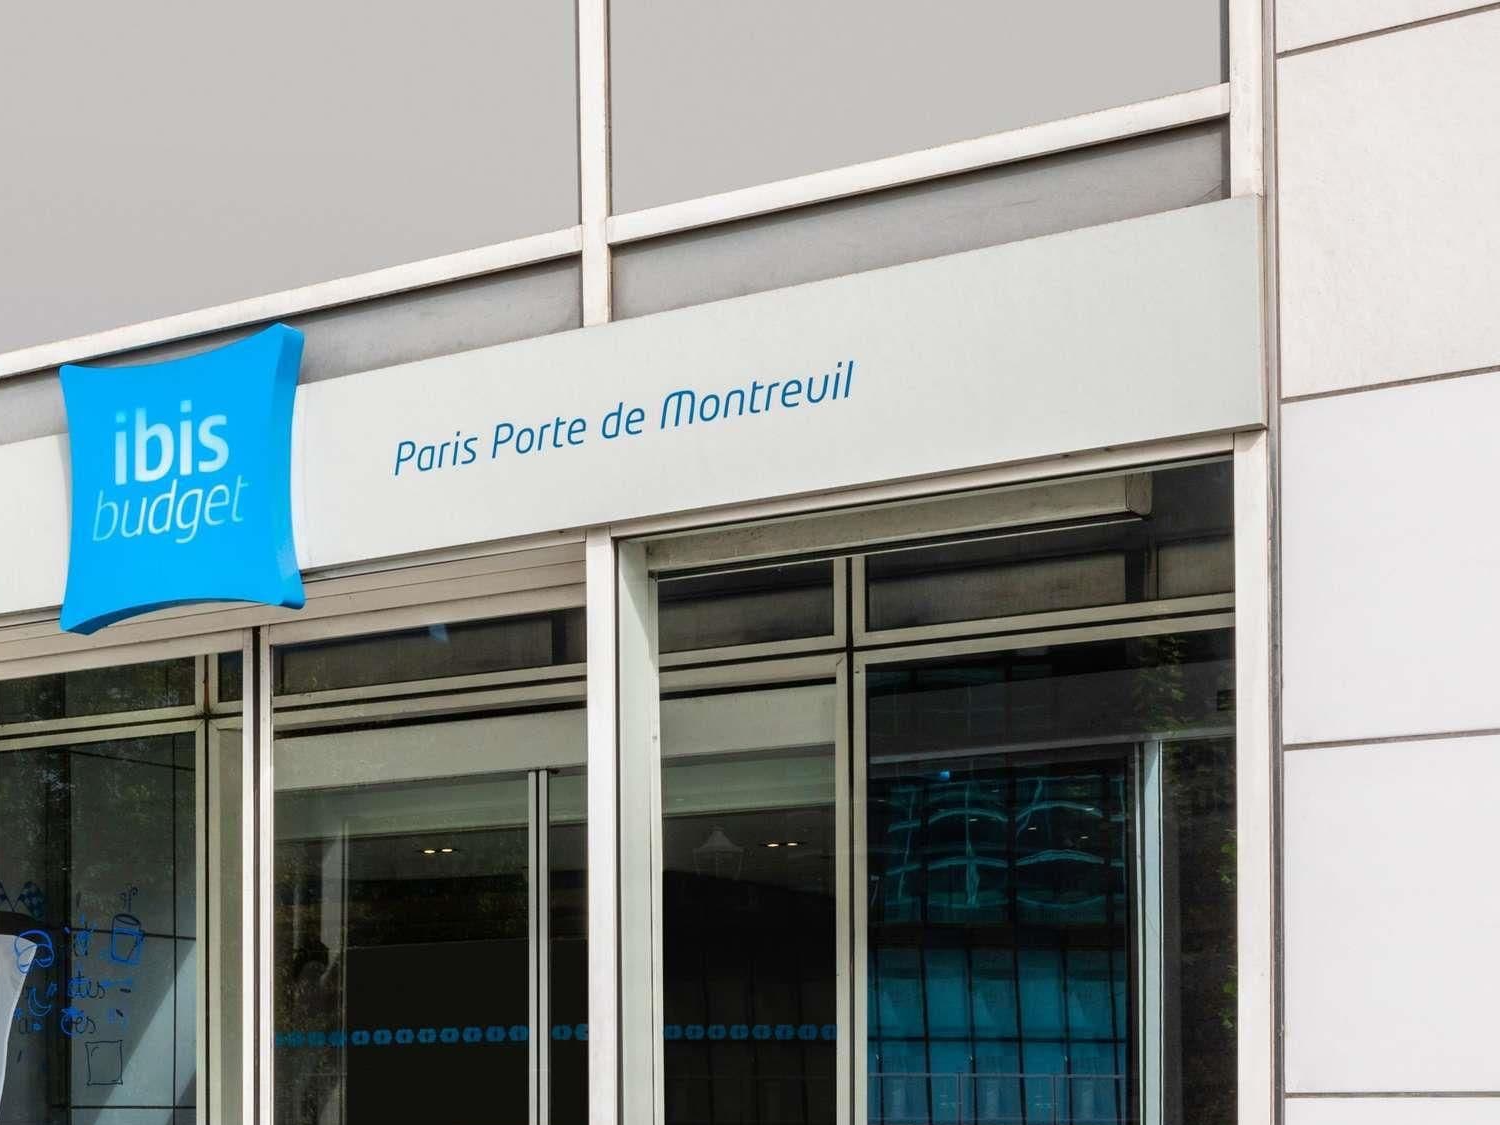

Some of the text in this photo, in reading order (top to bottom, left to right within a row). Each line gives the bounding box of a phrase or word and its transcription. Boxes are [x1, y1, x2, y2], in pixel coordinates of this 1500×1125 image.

[114, 399, 230, 486] ibis
[393, 359, 855, 476] Paris Porte de Montreuil
[91, 474, 250, 544] budget
